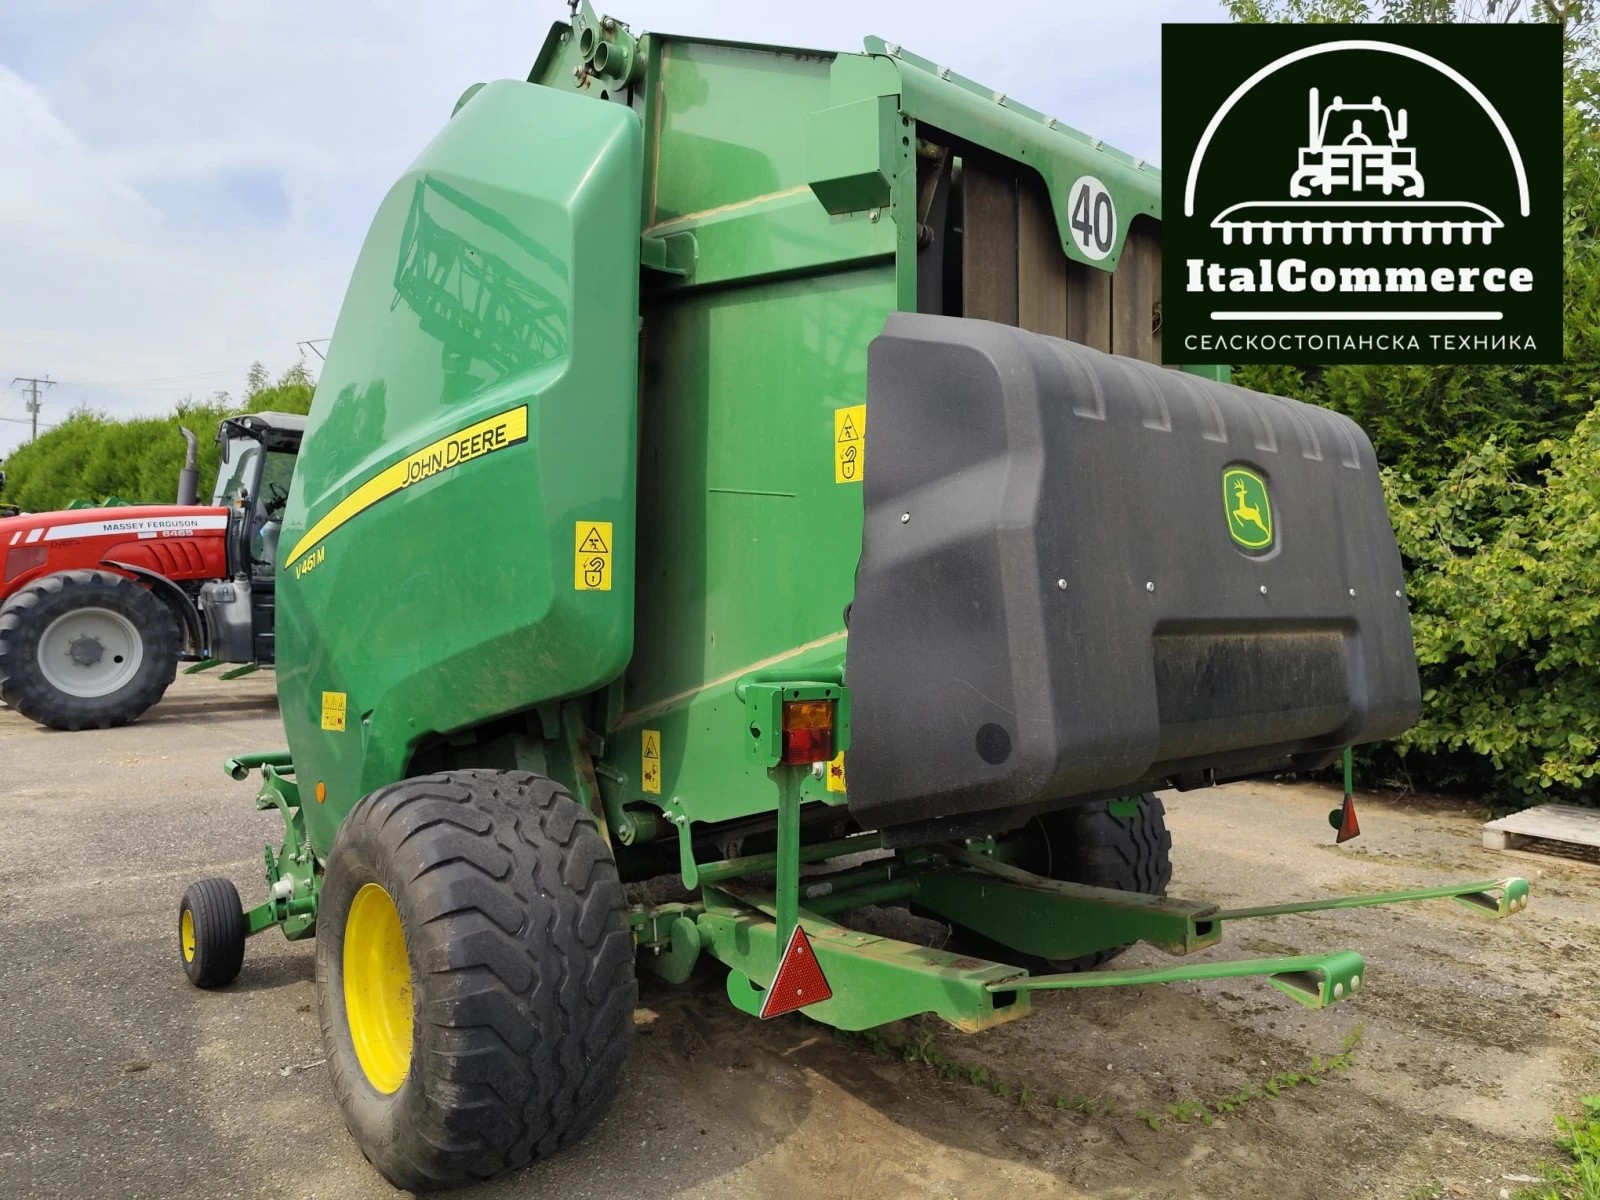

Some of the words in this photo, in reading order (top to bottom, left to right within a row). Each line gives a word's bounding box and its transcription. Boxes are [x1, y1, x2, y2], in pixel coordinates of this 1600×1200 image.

[1071, 184, 1114, 253] 40
[402, 450, 443, 485] JOHN
[446, 423, 507, 465] DEERE
[102, 521, 144, 532] MASSEY
[147, 520, 198, 529] FERGUSON
